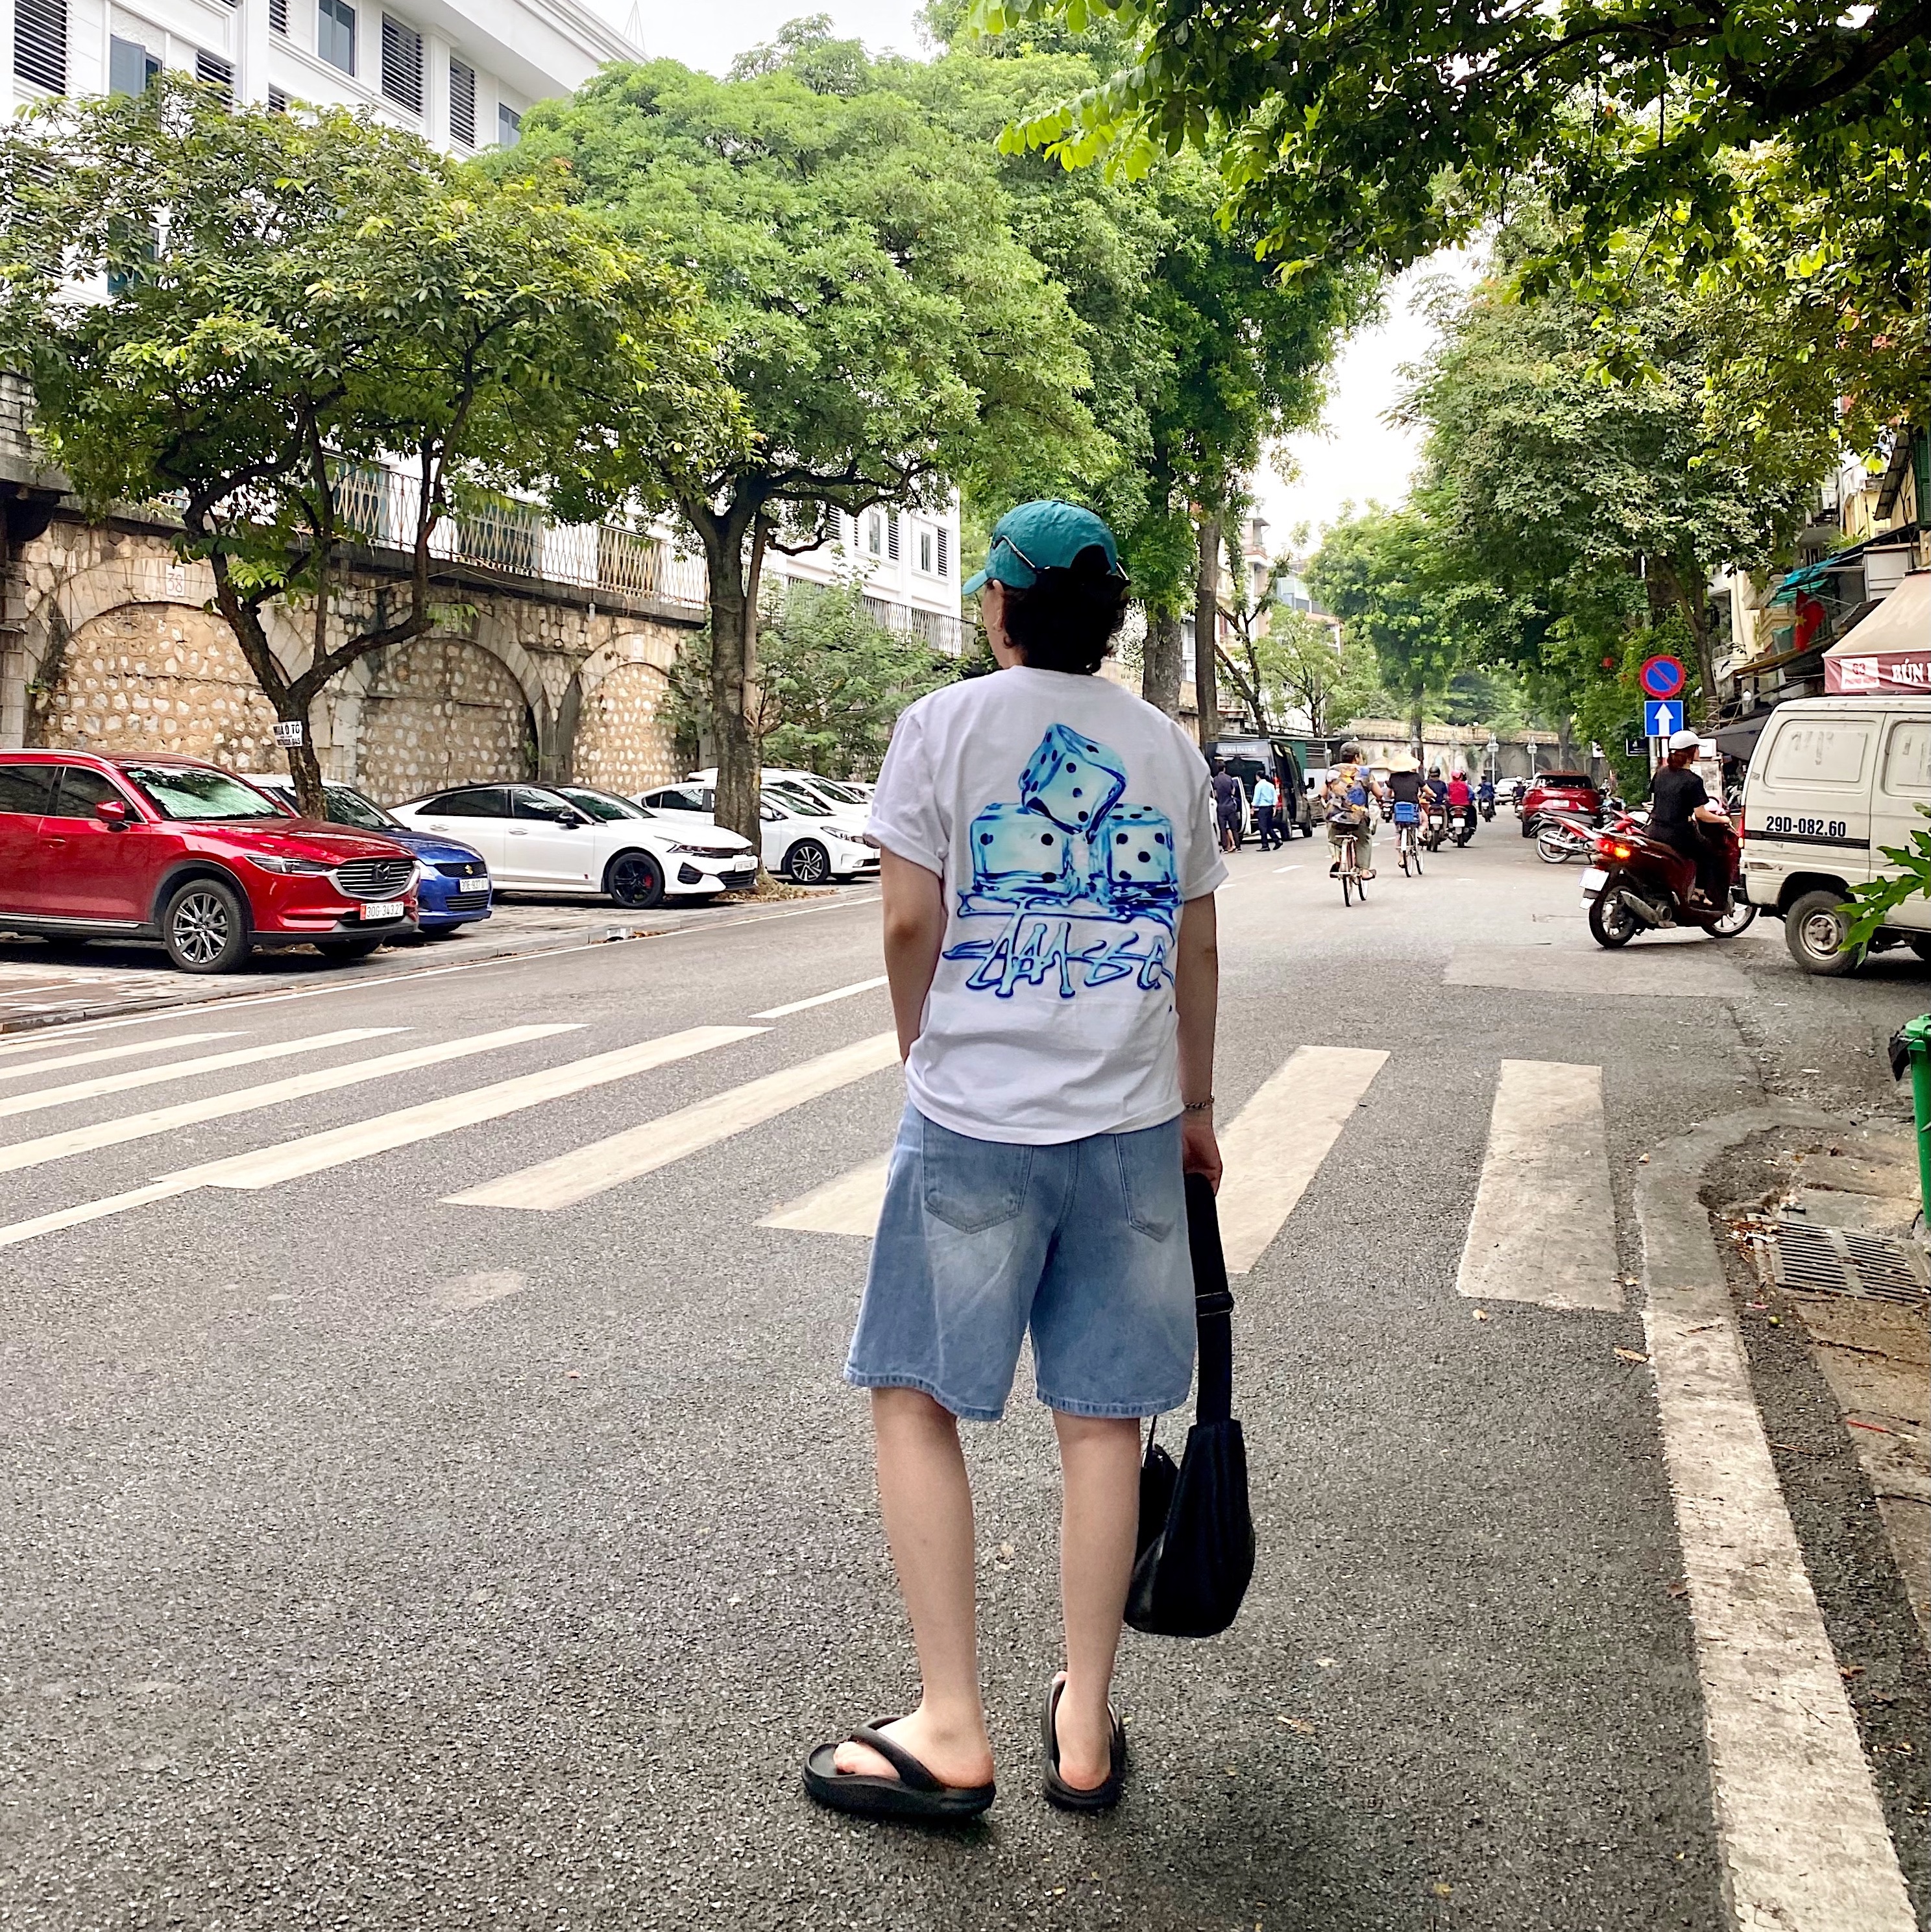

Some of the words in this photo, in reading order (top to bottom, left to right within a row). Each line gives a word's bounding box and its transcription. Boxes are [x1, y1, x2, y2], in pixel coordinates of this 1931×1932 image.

[167, 573, 182, 593] 38
[1891, 658, 1924, 682] BÚN
[1766, 815, 1846, 837] 29D-082.60
